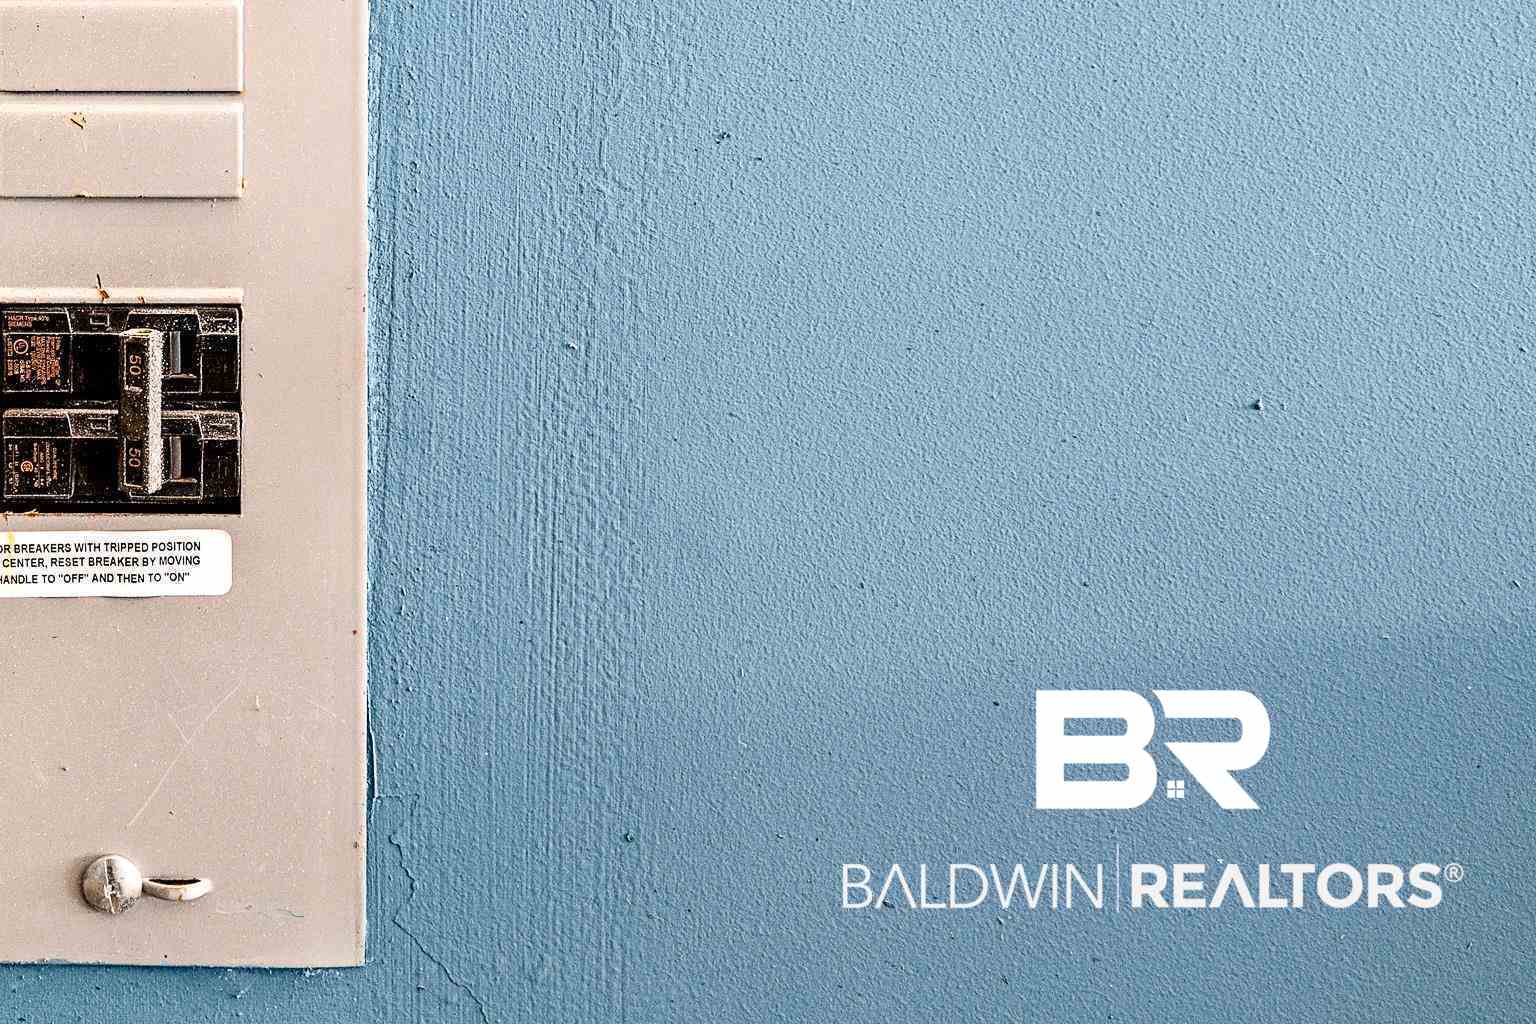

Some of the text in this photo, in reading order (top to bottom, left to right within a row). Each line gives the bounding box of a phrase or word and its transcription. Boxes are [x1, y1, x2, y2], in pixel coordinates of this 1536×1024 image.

[129, 354, 143, 376] 50
[128, 447, 142, 469] 50
[13, 543, 72, 554] BREAKERS
[73, 542, 102, 553] WITH
[103, 542, 150, 553] TRIPPED
[151, 541, 202, 552] POSITION
[2, 558, 49, 569] CENTER,
[50, 557, 86, 568] RESET
[88, 556, 140, 567] BREAKER
[142, 556, 157, 567] BY
[159, 555, 201, 566] MOVING
[40, 574, 56, 584] TO
[58, 573, 90, 584] "OFF"
[91, 573, 114, 584] AND
[116, 573, 145, 584] THEN
[148, 572, 162, 583] TO
[164, 572, 191, 583] "ON"
